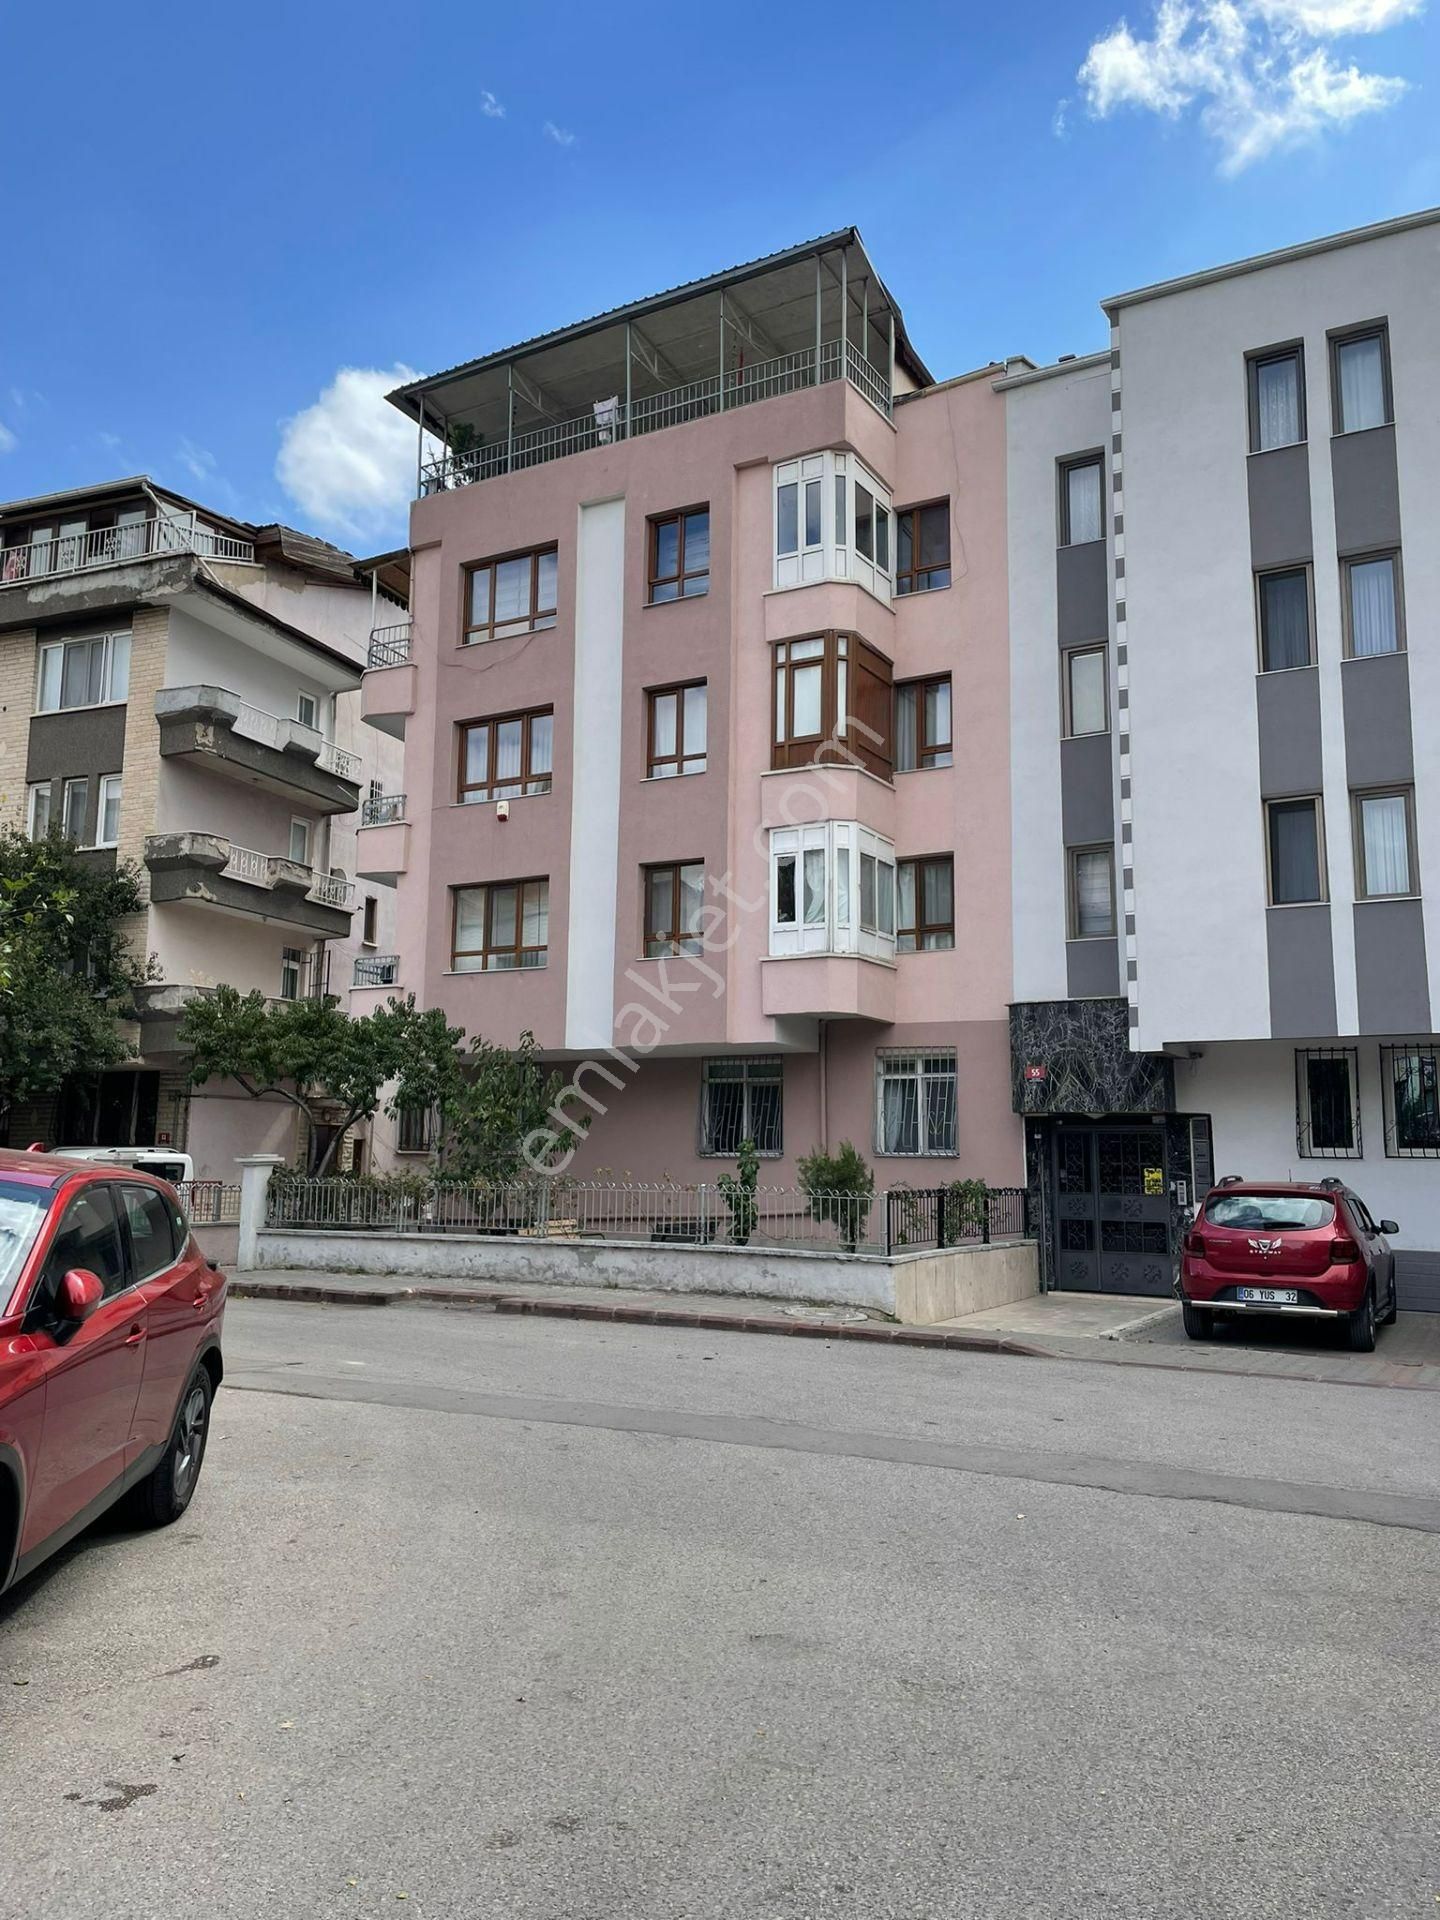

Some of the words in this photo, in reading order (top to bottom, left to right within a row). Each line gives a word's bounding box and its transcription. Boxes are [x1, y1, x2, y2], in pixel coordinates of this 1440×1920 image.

[1031, 1068, 1041, 1077] 55
[1243, 1289, 1254, 1299] 06
[1259, 1289, 1275, 1301] YUS
[1285, 1291, 1297, 1302] 32
